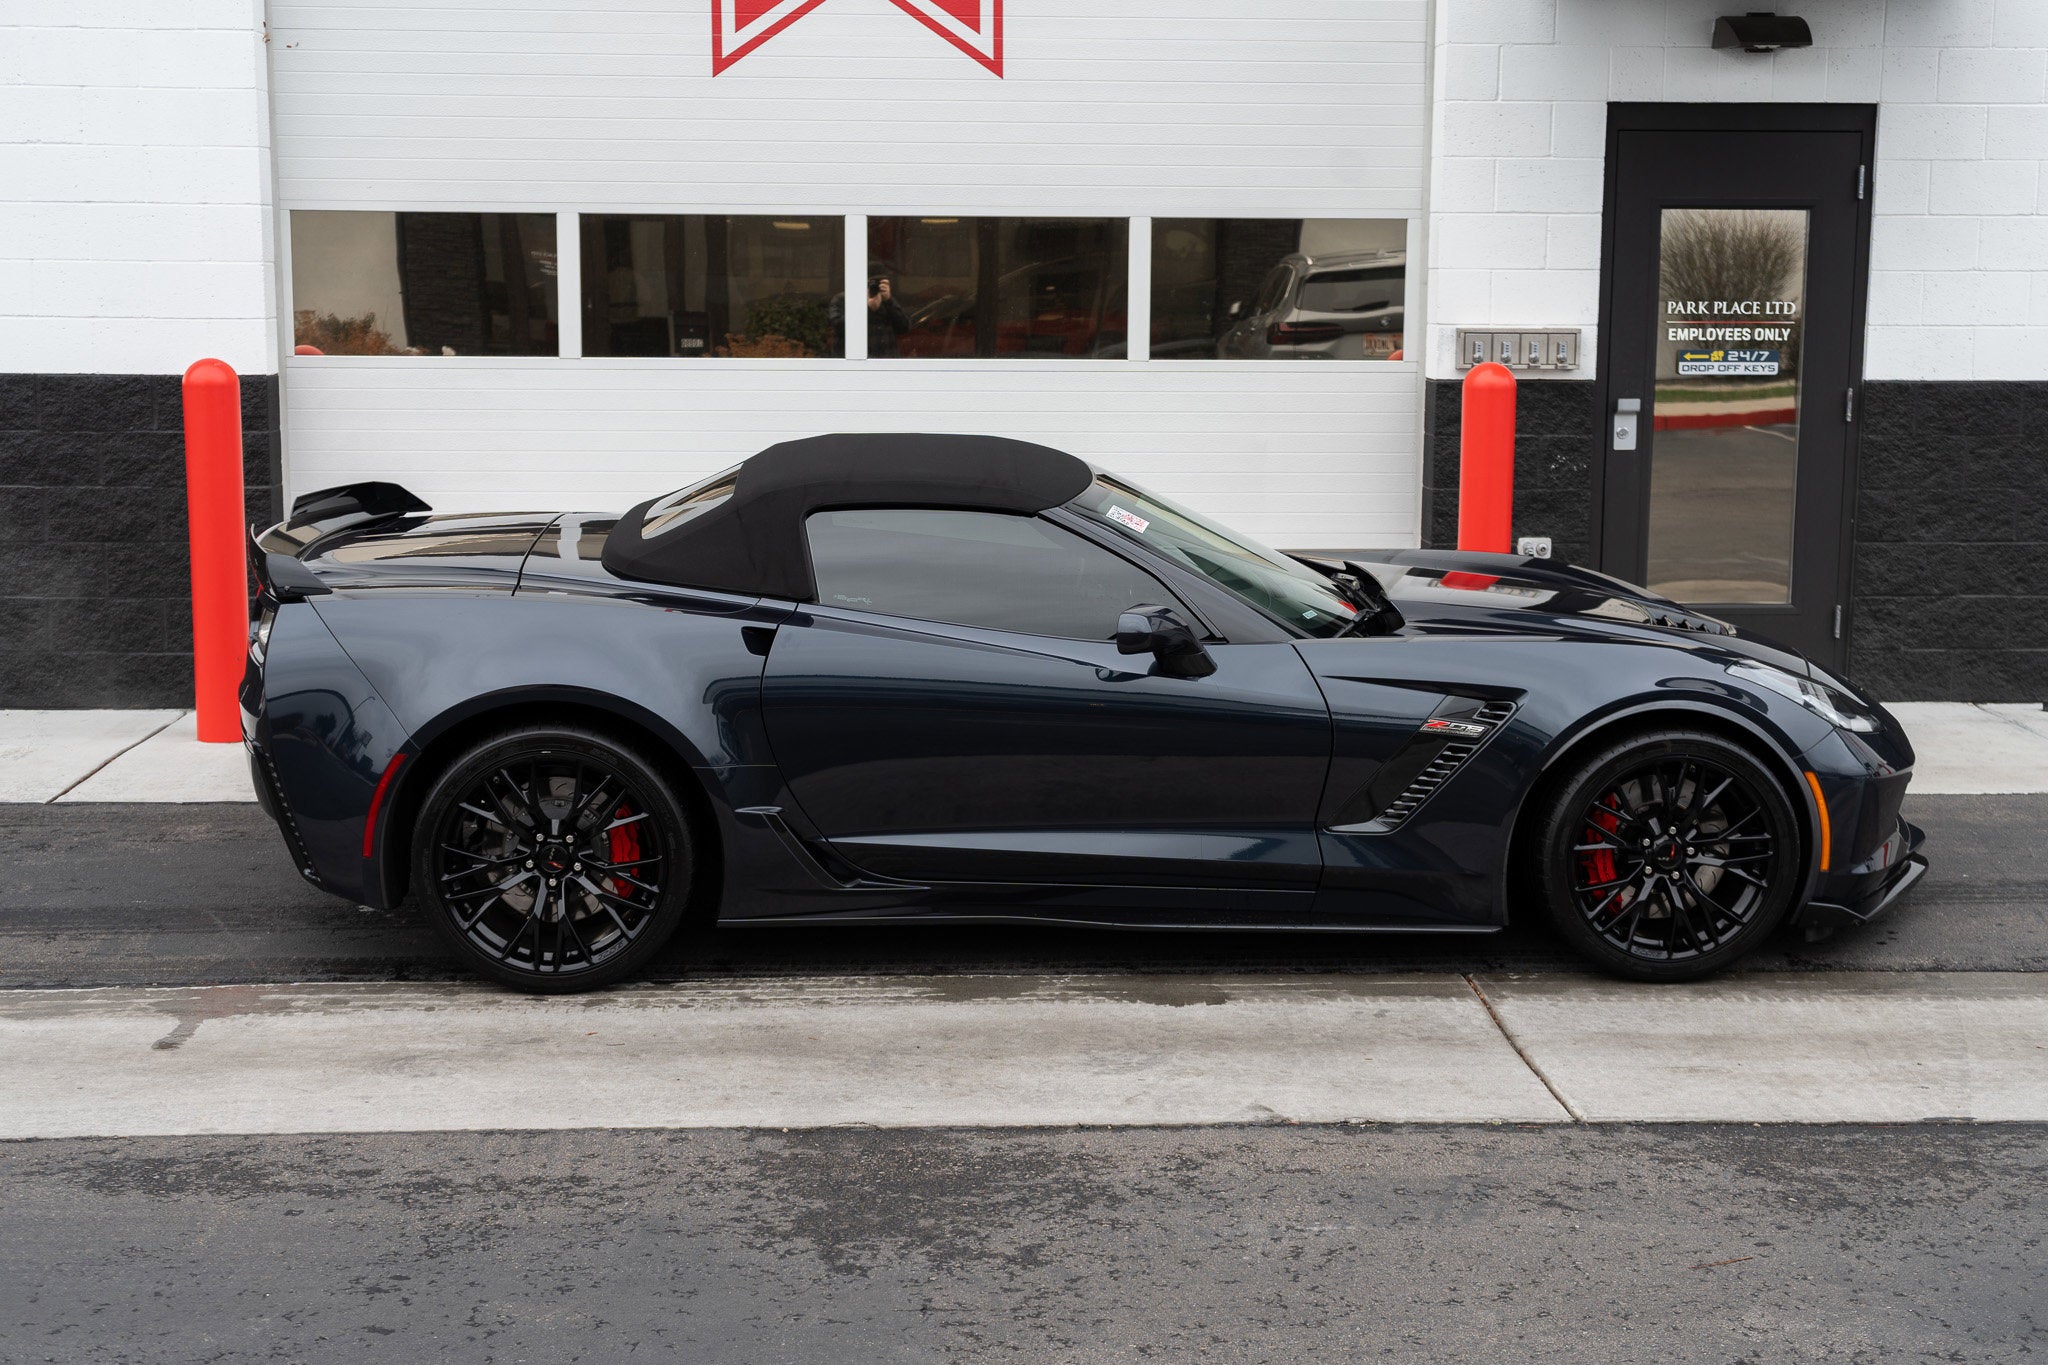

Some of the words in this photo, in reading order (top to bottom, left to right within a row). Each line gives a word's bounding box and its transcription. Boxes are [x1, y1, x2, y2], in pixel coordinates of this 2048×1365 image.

[1666, 300, 1710, 315] PARK
[1713, 300, 1761, 315] PLACE
[1765, 300, 1797, 315] LTD
[1668, 327, 1752, 341] EMPLOYEES
[1754, 327, 1791, 341] ONLY
[1727, 350, 1770, 362] 24/7
[1681, 364, 1715, 372] DROP
[1717, 364, 1742, 372] OFF
[1744, 364, 1776, 373] KEYS
[1423, 719, 1486, 733] Z06
